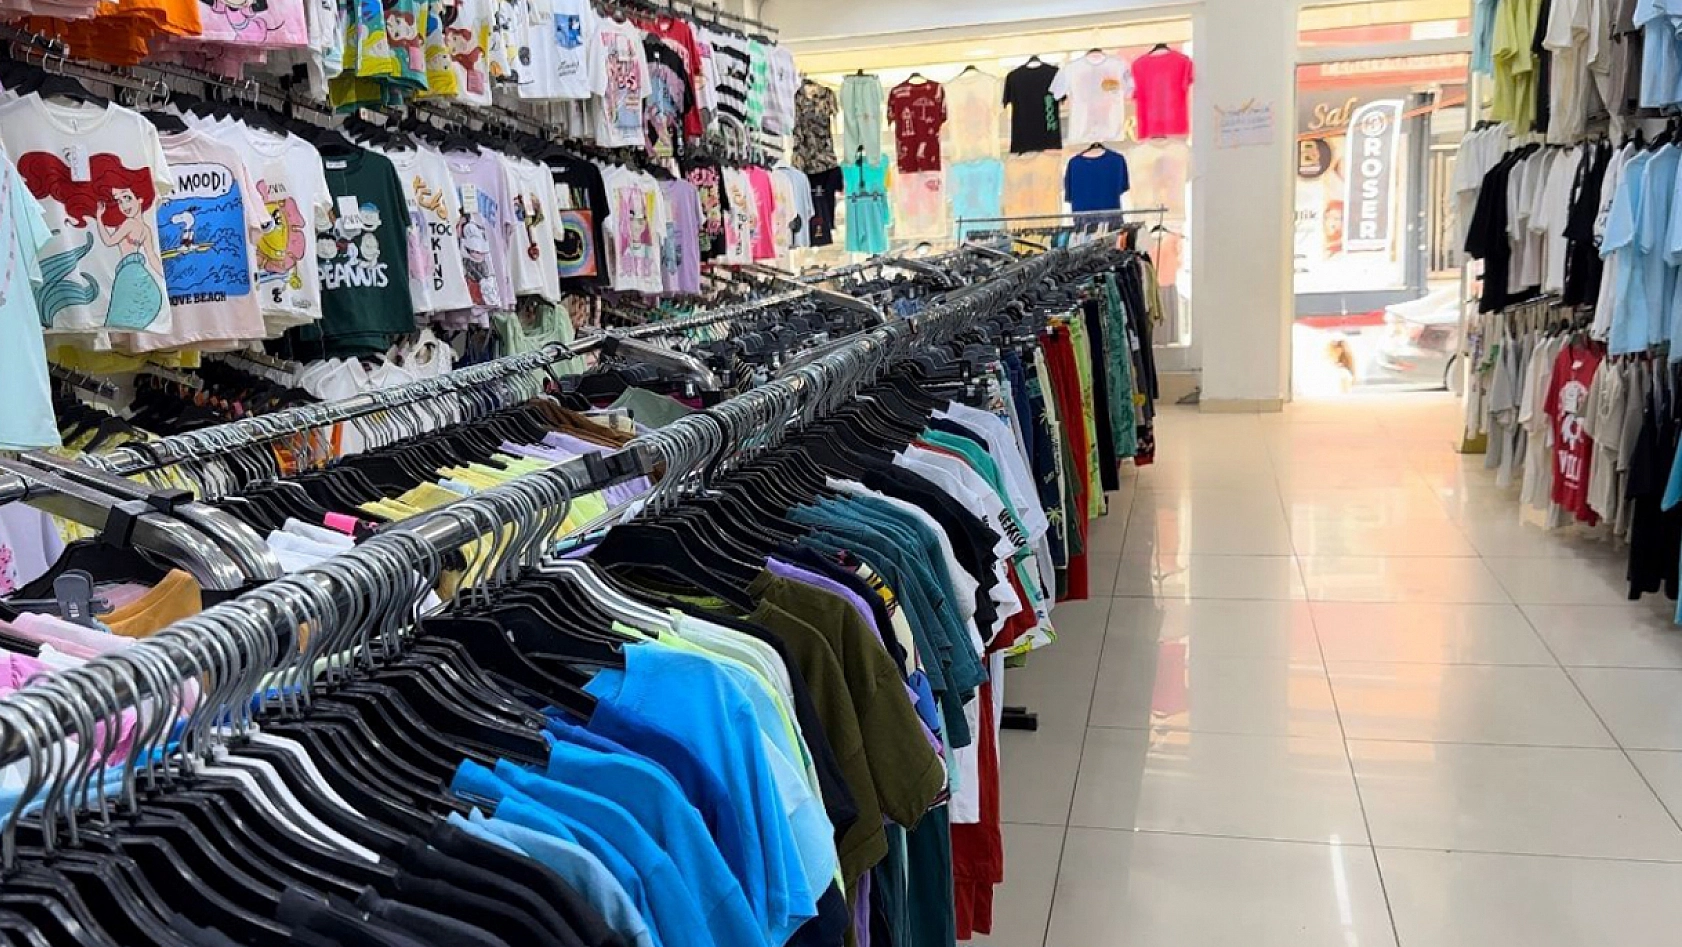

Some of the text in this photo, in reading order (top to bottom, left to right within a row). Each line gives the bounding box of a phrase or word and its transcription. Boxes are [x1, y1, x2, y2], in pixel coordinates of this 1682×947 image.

[178, 171, 226, 193] MOOD!
[1359, 137, 1383, 239] ROSER
[193, 291, 226, 304] BEACH
